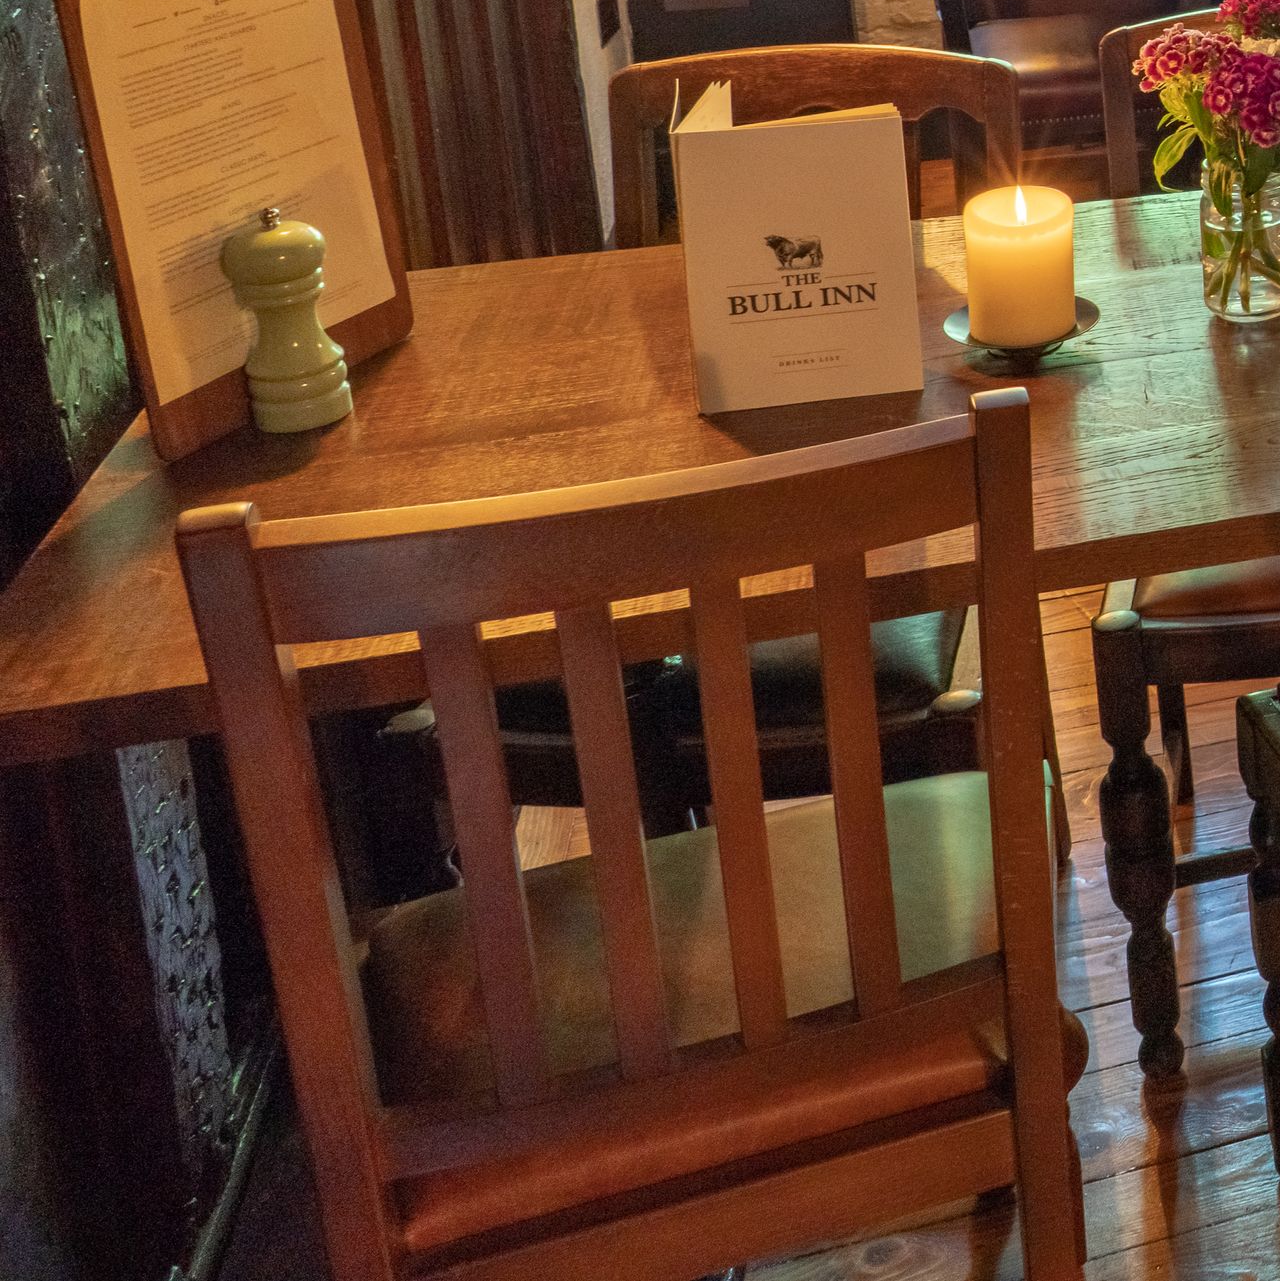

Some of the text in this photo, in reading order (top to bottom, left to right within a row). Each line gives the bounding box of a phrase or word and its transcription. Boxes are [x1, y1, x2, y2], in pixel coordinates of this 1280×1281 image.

[781, 272, 822, 287] THE
[727, 282, 878, 316] BULL INN
[778, 355, 841, 368] DRINKS LIST
